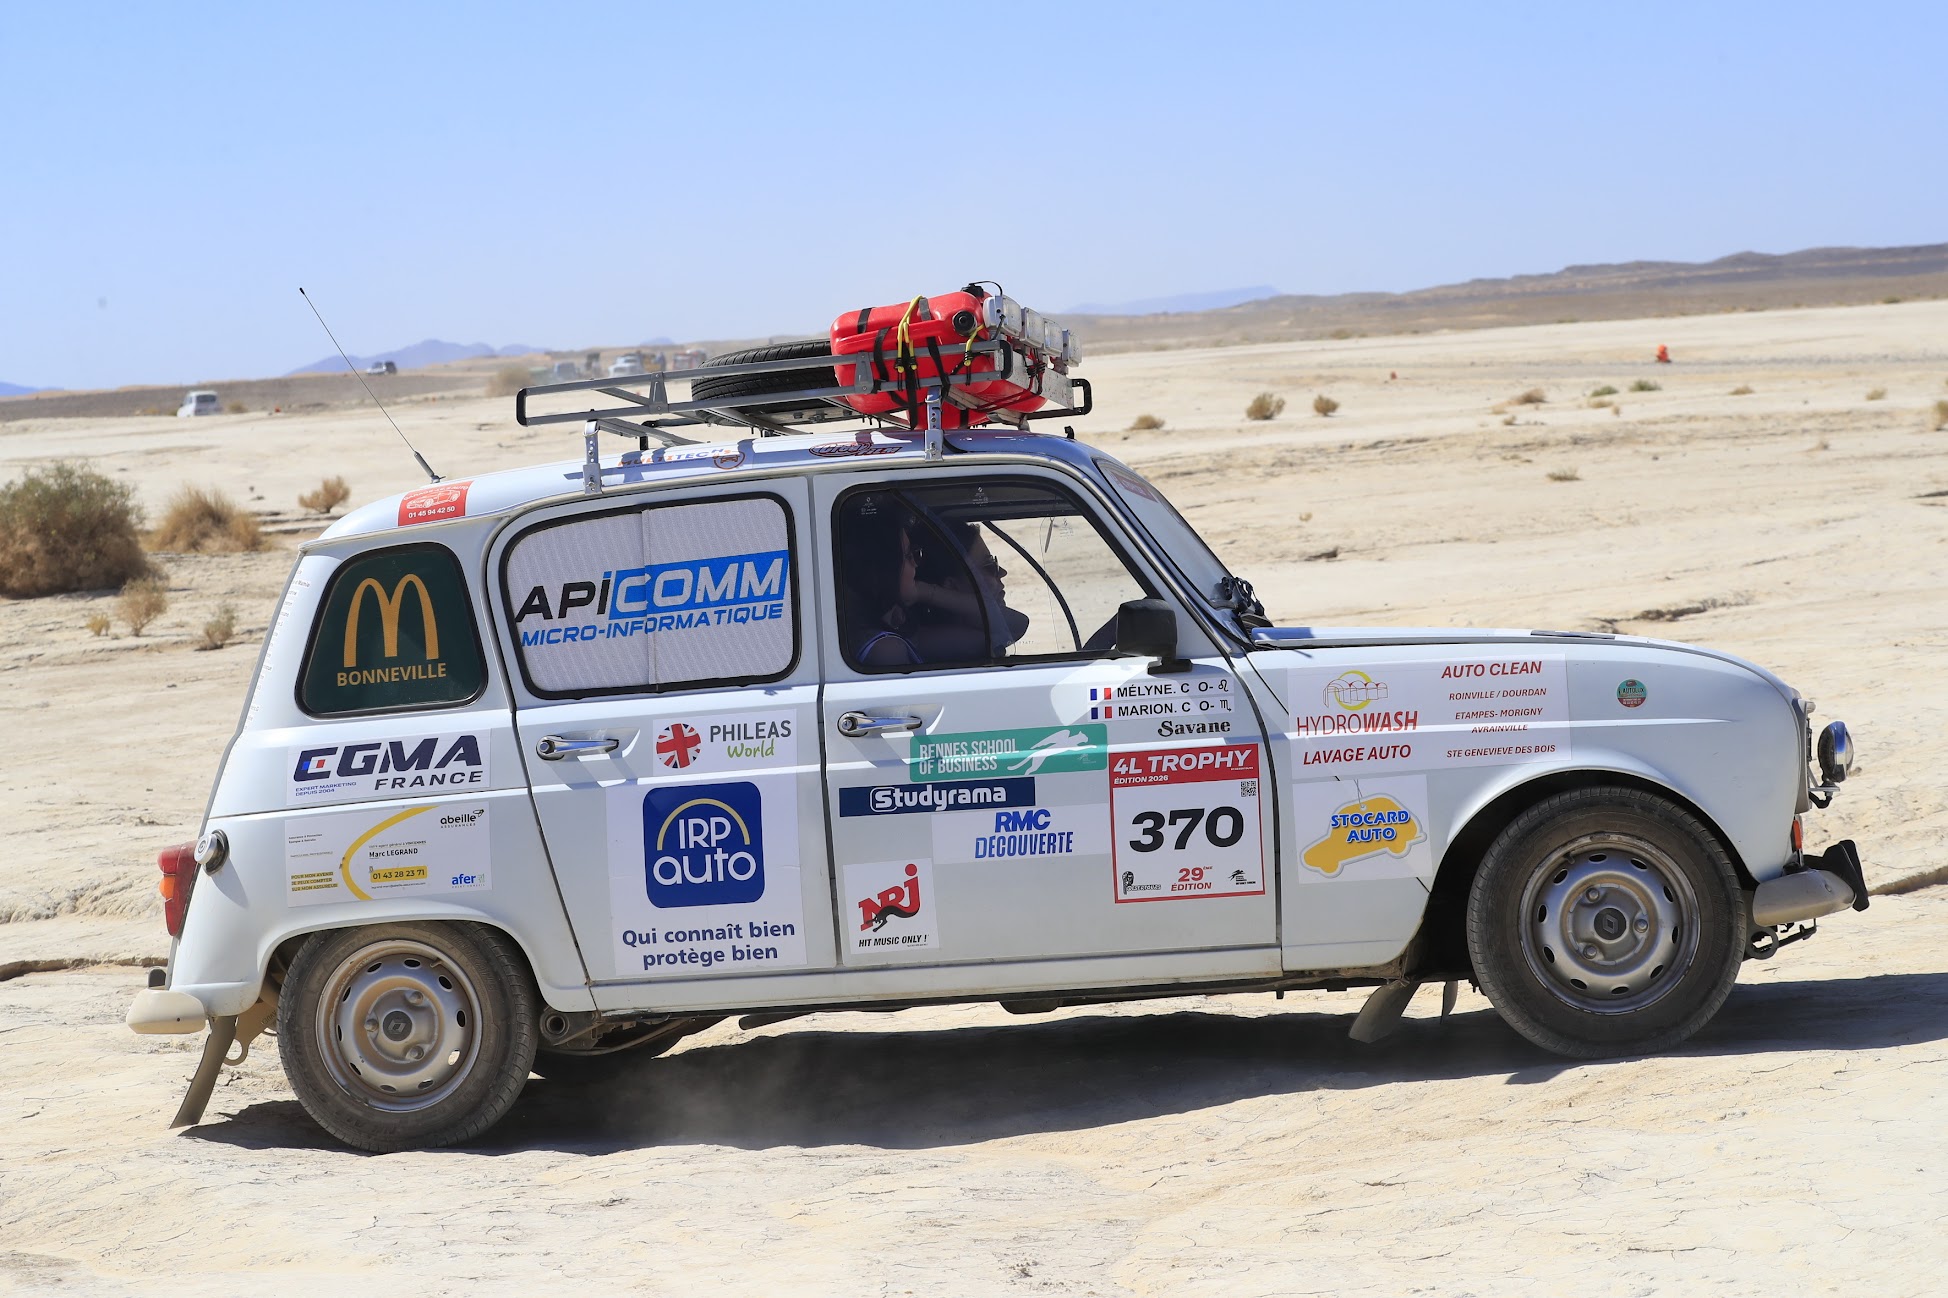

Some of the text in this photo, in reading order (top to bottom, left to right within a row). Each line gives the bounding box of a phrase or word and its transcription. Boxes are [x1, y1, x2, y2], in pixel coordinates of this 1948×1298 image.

[521, 602, 784, 646] MICRO-INFORMATIQUE
[337, 662, 447, 687] BONNEVILLE
[1441, 660, 1542, 678] AUTO CLEAN
[1117, 684, 1176, 698] MÉLYNE.
[1180, 683, 1190, 693] C
[1449, 690, 1496, 701] ROINVILLE
[1502, 688, 1547, 698] DOURDAN
[1118, 703, 1177, 717] MARION.
[1182, 702, 1191, 712] C
[1500, 708, 1544, 717] MORIGNY
[710, 720, 792, 742] PHILEAS
[1158, 720, 1231, 737] Savane
[1296, 710, 1418, 736] HYDROWASH
[1472, 724, 1528, 733] AVRAINVILLE
[293, 734, 482, 782] CGMA
[727, 739, 775, 759] World
[920, 739, 1019, 759] RENNES SCHOOL
[1303, 744, 1412, 765] LAVAGE AUTO
[1447, 744, 1556, 758] STE GENEVIEVE DES BOIS
[920, 756, 998, 775] OF BUSINESS
[1113, 757, 1142, 774] 4L
[1148, 749, 1252, 773] TROPHY
[320, 781, 357, 789] MARKETING
[374, 770, 483, 790] FRANCE
[1114, 776, 1147, 784] ÉDITION
[872, 784, 1006, 812] Studyrama
[440, 814, 476, 825] abeille
[994, 808, 1051, 832] RMC
[1331, 810, 1410, 827] STOCARD
[679, 816, 732, 850] IRP
[1129, 806, 1244, 852] 370
[1346, 827, 1396, 843] AUTO
[387, 848, 418, 856] LEGRAND
[653, 848, 757, 886] auto
[452, 874, 476, 885] afer
[1171, 882, 1212, 892] ÉDITION
[622, 921, 795, 946] Qui connaît bien
[859, 939, 872, 947] HIT
[874, 936, 899, 946] MUSIC
[901, 935, 922, 944] ONLY
[642, 945, 778, 970] protège bien
